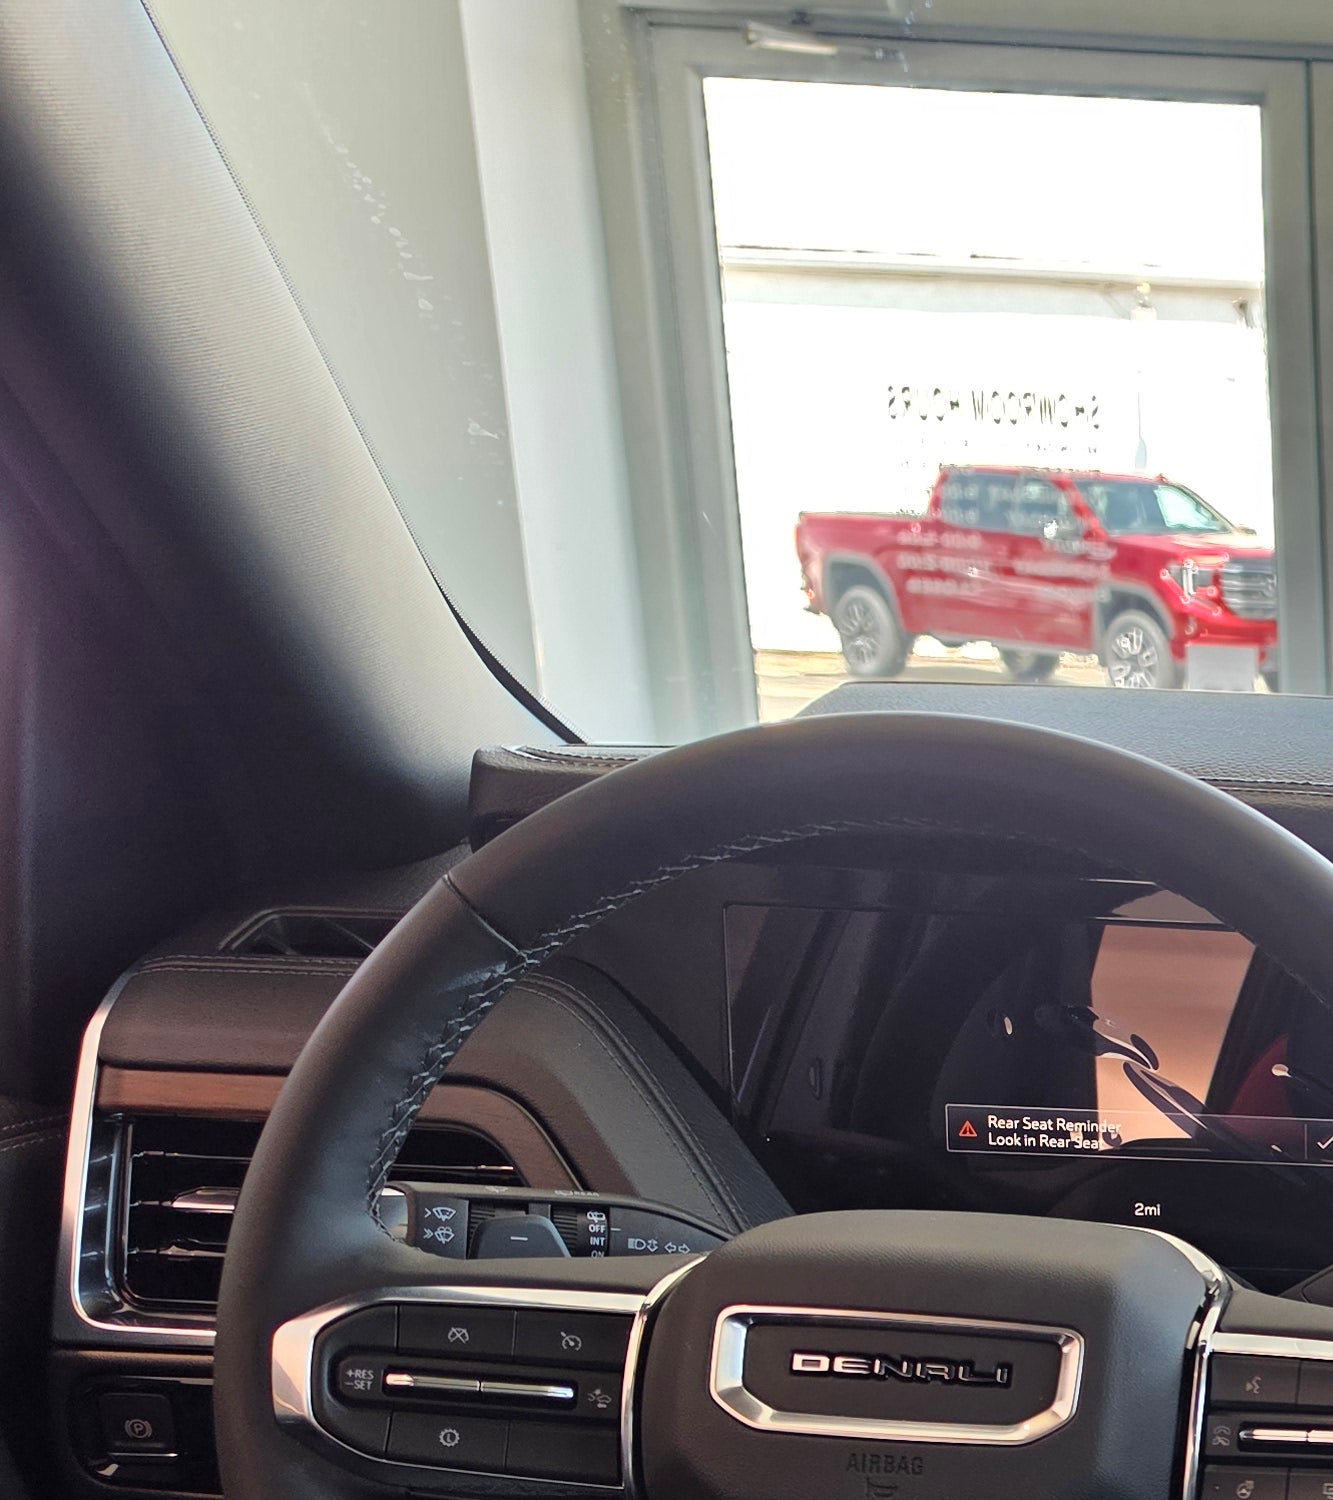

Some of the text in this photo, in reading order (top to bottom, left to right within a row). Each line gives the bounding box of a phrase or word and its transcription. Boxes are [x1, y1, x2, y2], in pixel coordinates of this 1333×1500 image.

[987, 1115, 1121, 1135] Rear Seat Reminder
[988, 1133, 1105, 1150] Look in Rear Seat
[1134, 1202, 1160, 1216] 2mi
[588, 1224, 606, 1233] OFF
[590, 1236, 606, 1246] INT
[791, 1353, 1008, 1385] DENALI
[846, 1453, 923, 1476] AIRBAG
